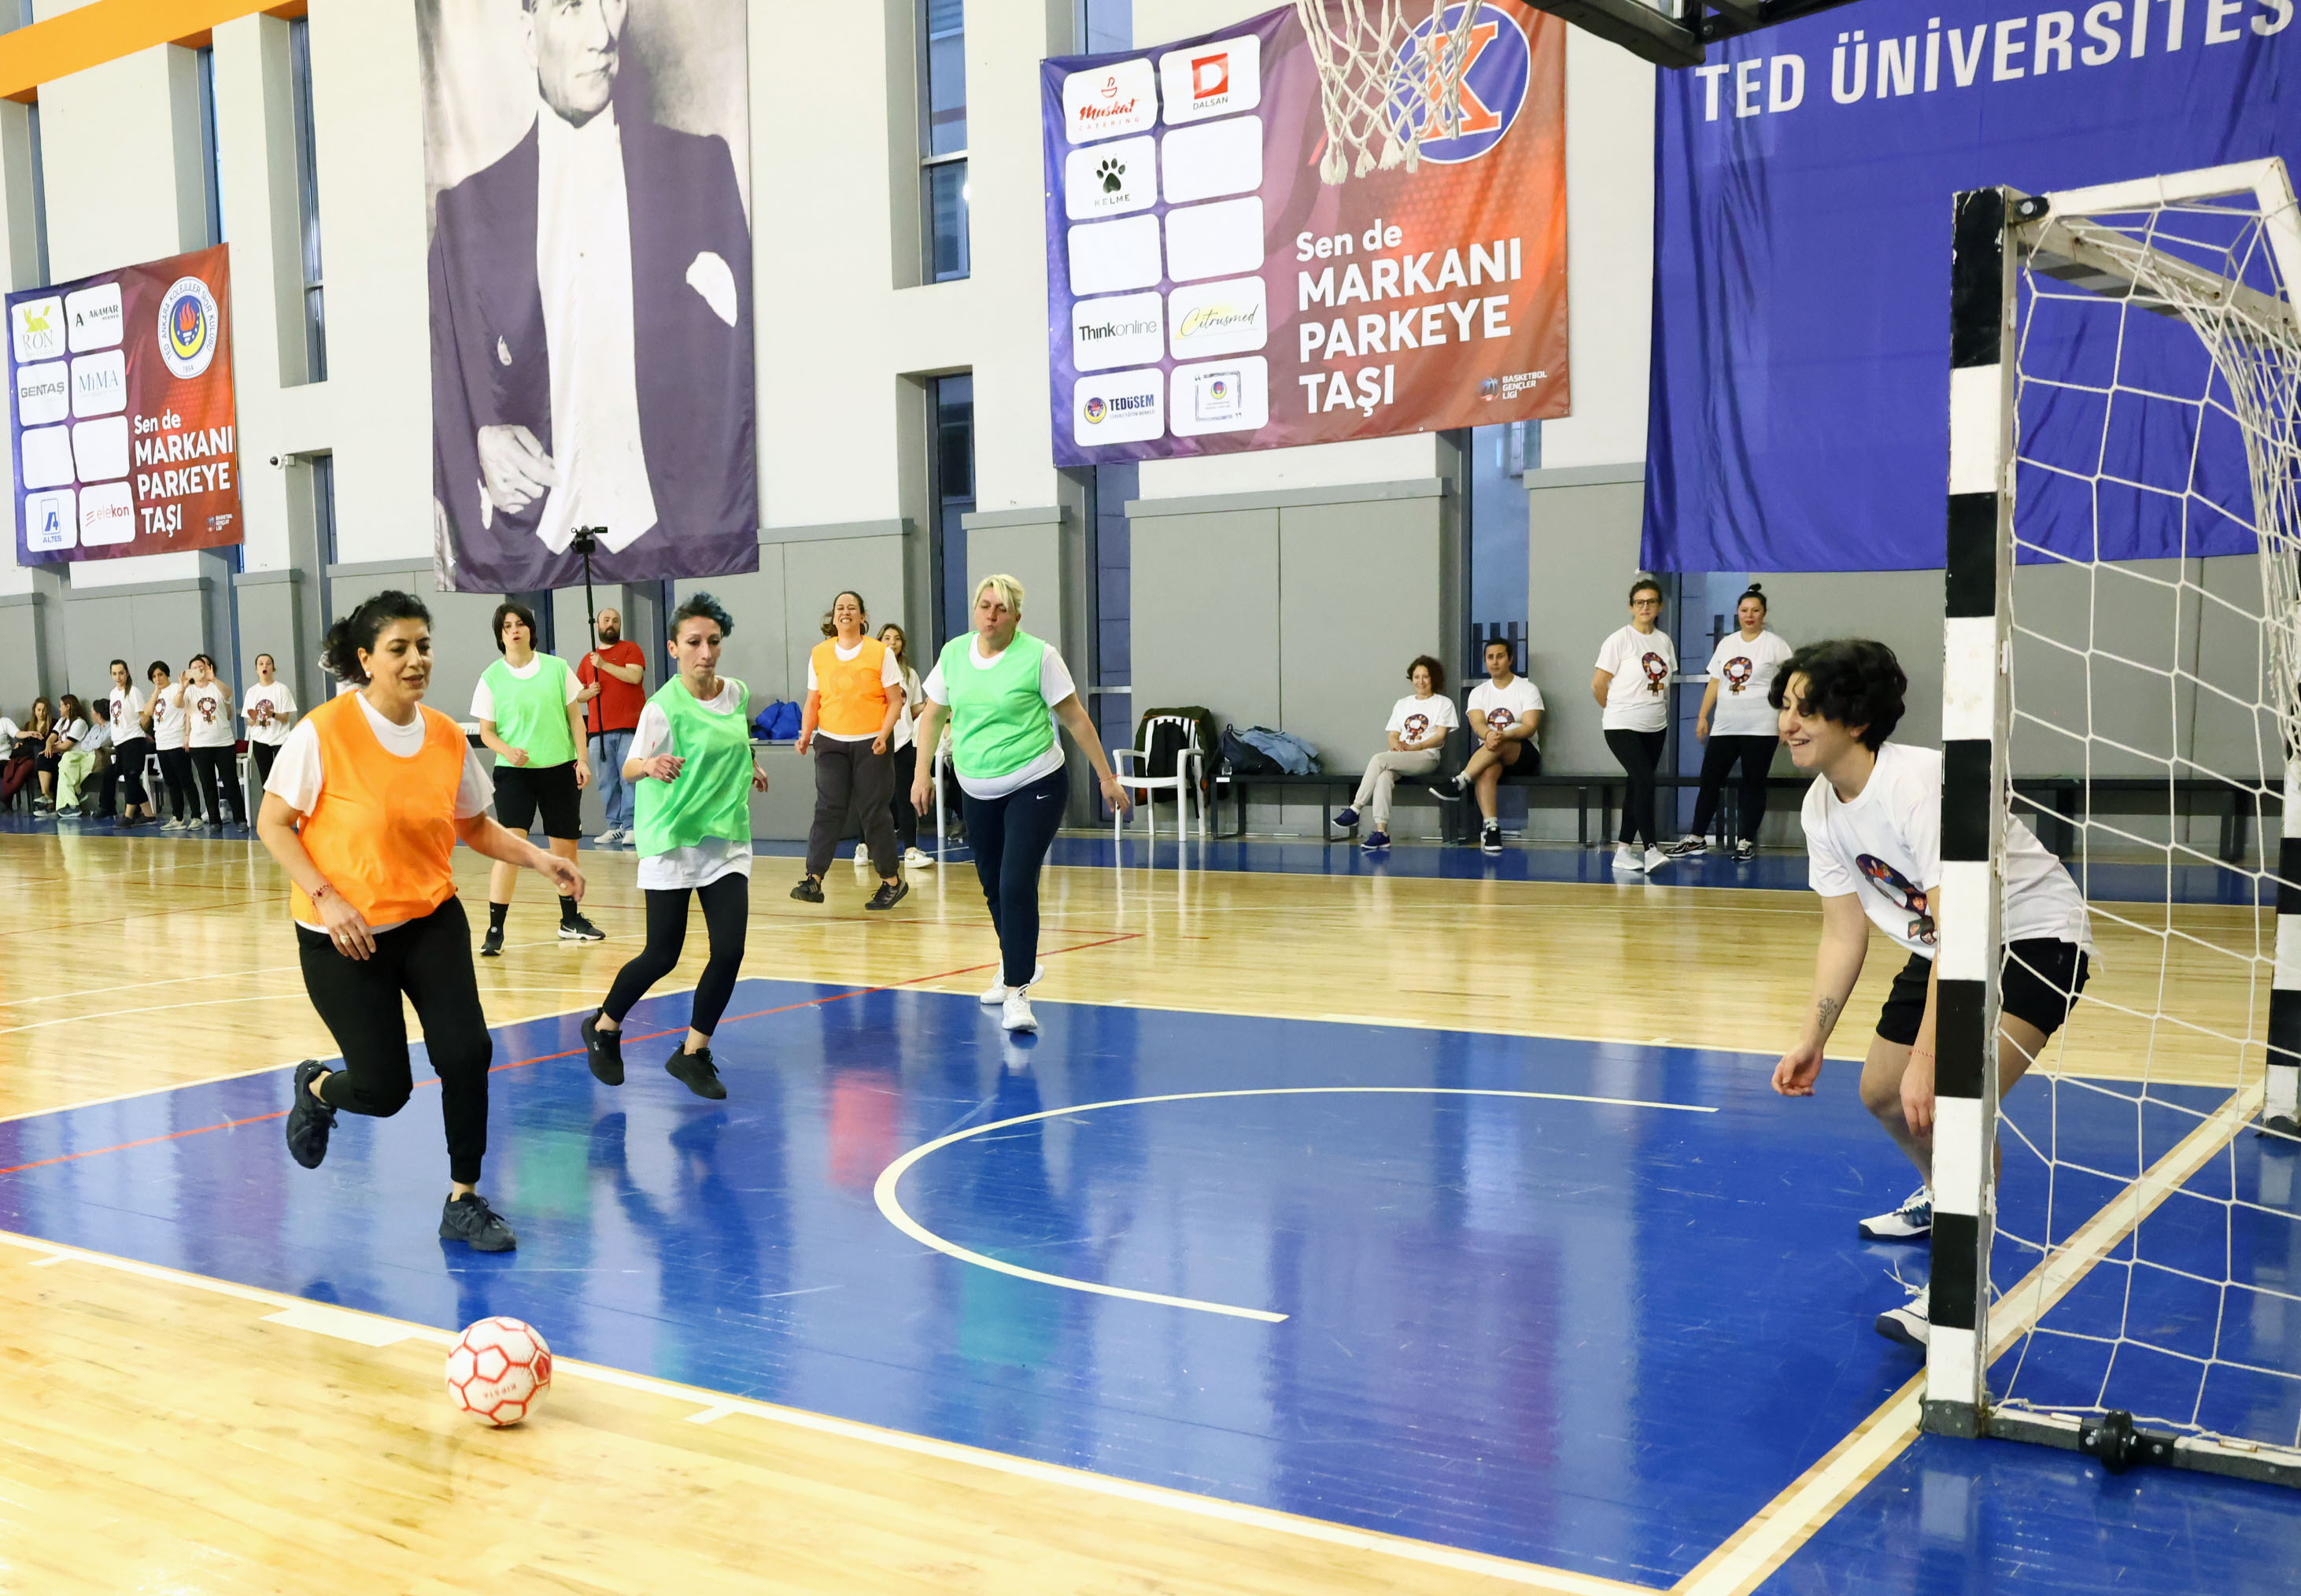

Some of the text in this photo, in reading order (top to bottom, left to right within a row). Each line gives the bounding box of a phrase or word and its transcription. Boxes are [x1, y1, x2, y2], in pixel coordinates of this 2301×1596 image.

[1415, 20, 1502, 144] K
[1694, 54, 1805, 122] TED
[1080, 98, 1140, 120] Muskat
[1193, 96, 1228, 110] DALSAN
[1095, 194, 1131, 207] KELME
[1296, 218, 1403, 263] Sen de
[1298, 237, 1522, 312] MARKANI
[89, 305, 119, 319] AKAMAR
[1180, 303, 1259, 337] Citrusmed
[22, 330, 54, 350] RON
[1079, 319, 1157, 342] Thinkonline
[1299, 294, 1512, 364] PARKEYE
[1502, 371, 1547, 383] BASKETBOL
[1502, 380, 1537, 392] GENÇLER
[20, 382, 65, 399] GENTAŞ
[1298, 364, 1395, 418] TAŞI
[1502, 390, 1517, 400] LİGİ
[134, 408, 182, 434] Sen de
[135, 426, 234, 467] MARKANI
[137, 461, 231, 501] PARKEYE
[96, 504, 130, 521] elekon
[140, 503, 182, 538] TAŞI
[42, 535, 62, 544] ALTES
